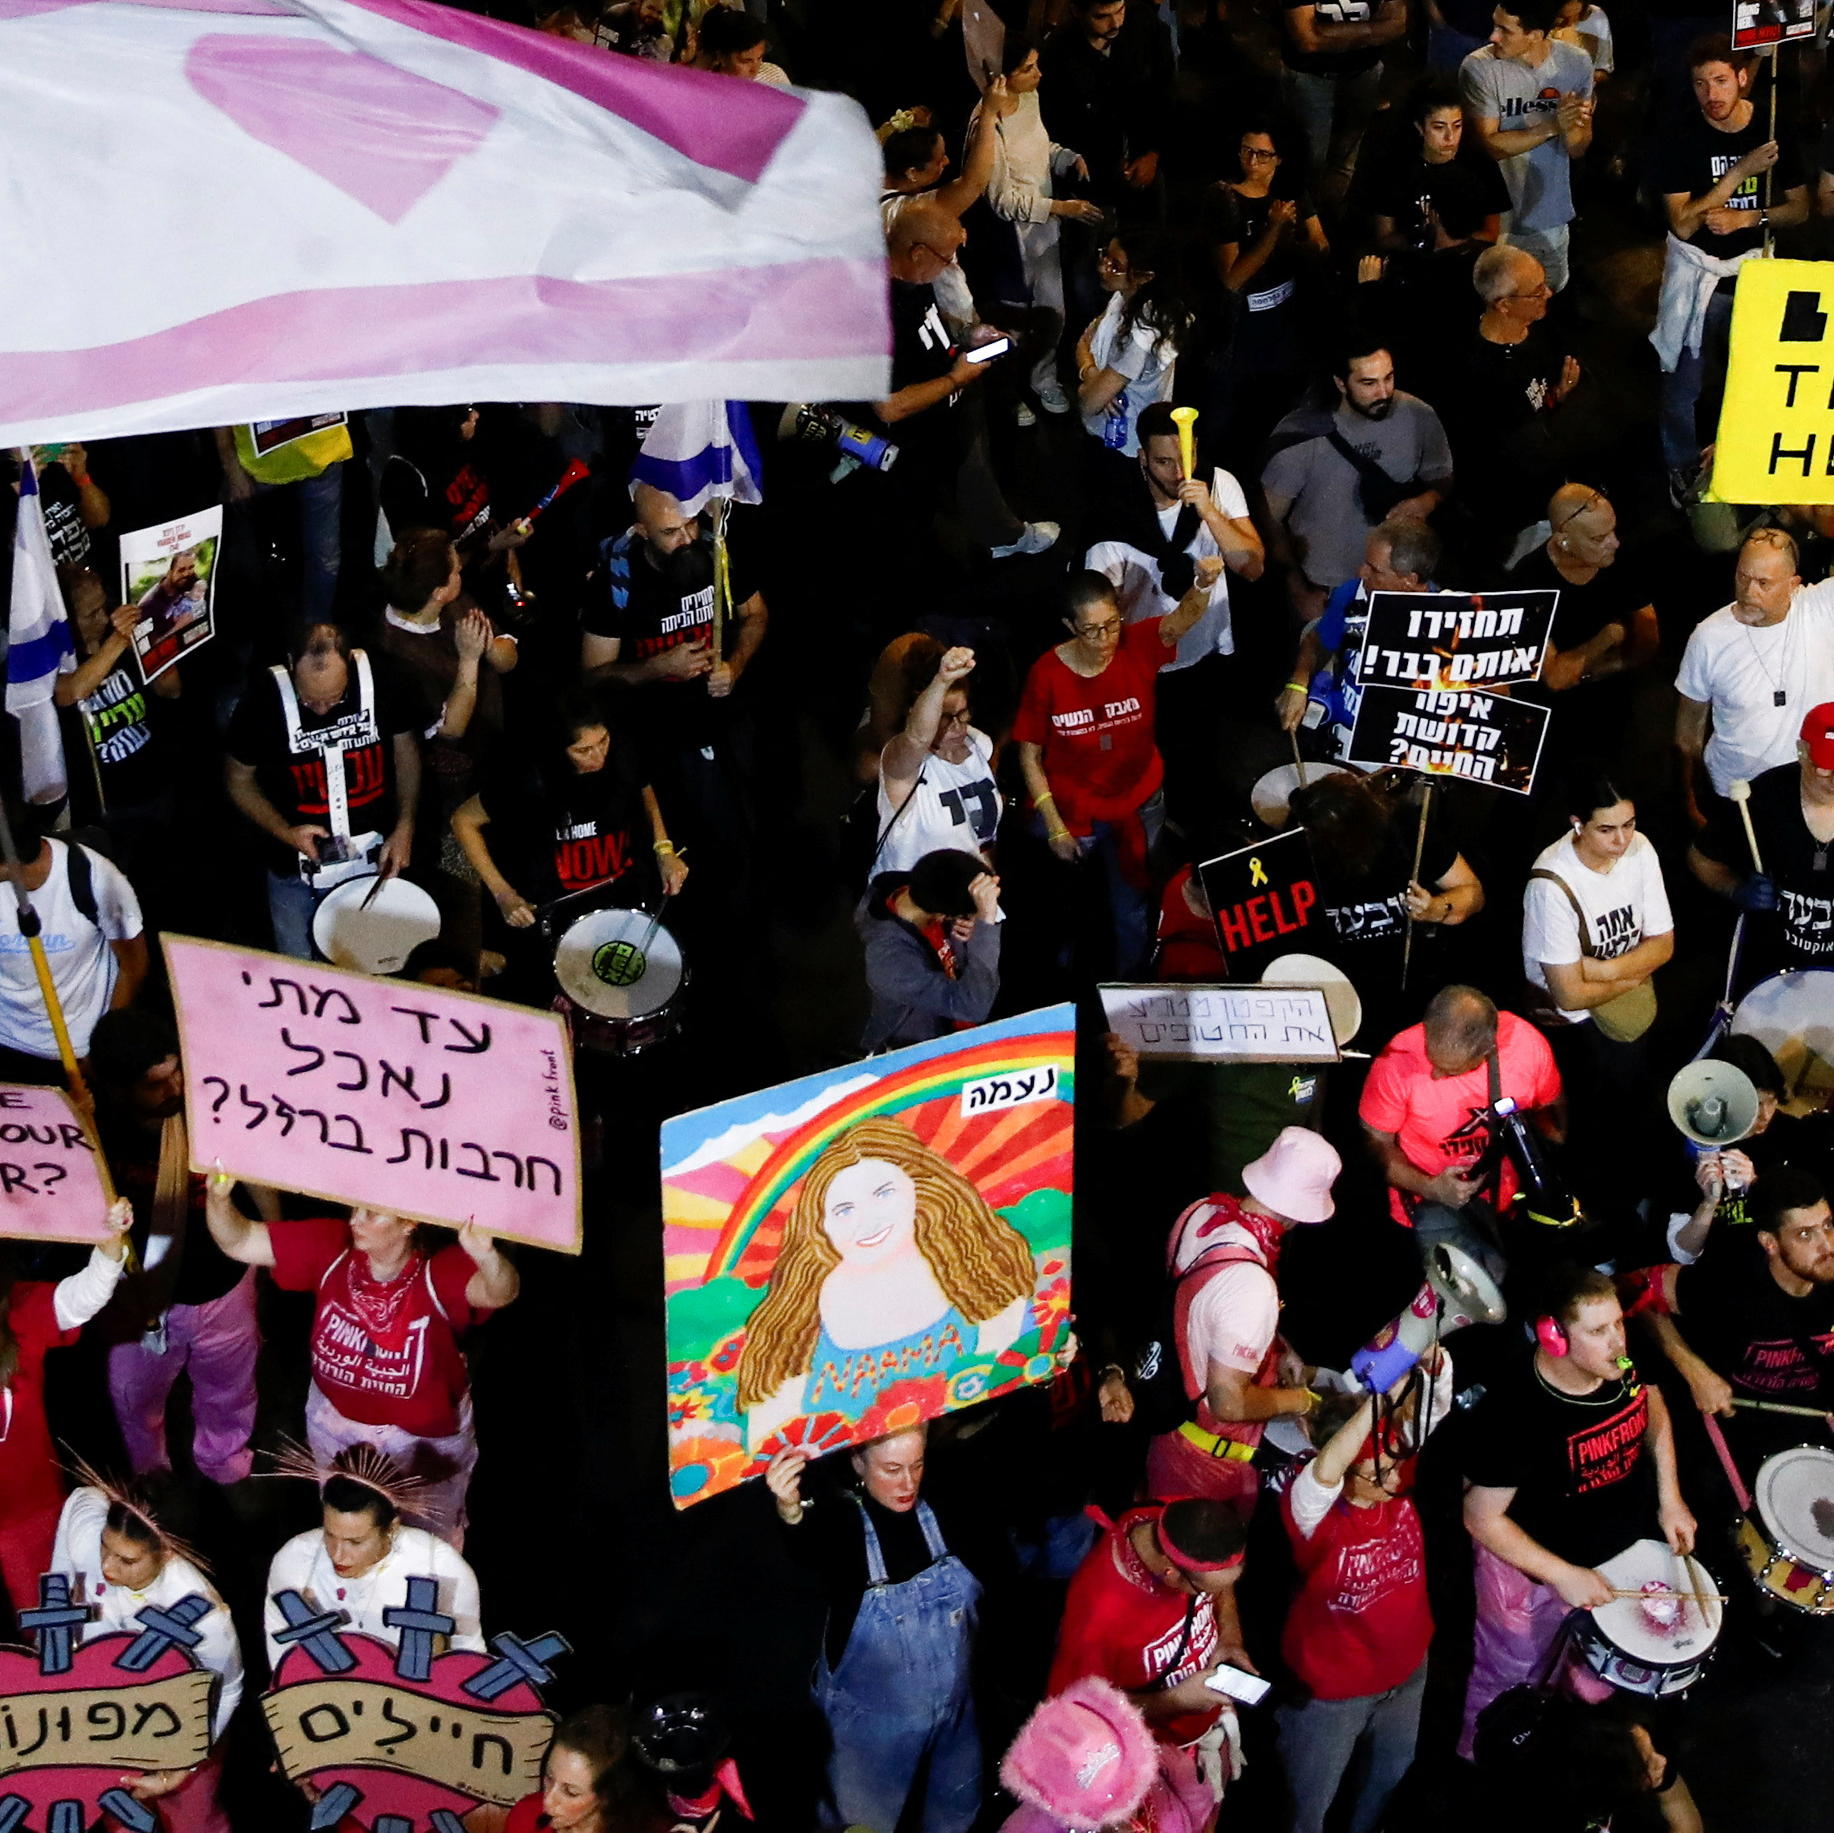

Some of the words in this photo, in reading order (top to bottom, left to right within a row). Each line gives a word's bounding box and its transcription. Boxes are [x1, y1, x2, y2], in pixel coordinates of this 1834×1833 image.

[1406, 608, 1525, 640] תחזירו
[1364, 645, 1443, 681] כבר!
[1448, 645, 1539, 683] אותם
[1051, 708, 1095, 729] הנשים
[1105, 695, 1141, 718] מאבק
[1413, 690, 1494, 721] איפה
[1393, 711, 1502, 752] קדושת
[1388, 738, 1497, 782] החיים?
[571, 821, 598, 839] HOME
[1217, 878, 1318, 952] HELP
[1595, 904, 1635, 940] אתה
[241, 970, 362, 1025] מתי
[391, 1004, 490, 1054] עד
[1141, 1021, 1268, 1044] החטופים
[1281, 1023, 1324, 1043] את
[282, 1026, 451, 1109] נאכל
[969, 1067, 1058, 1109] נעמה
[203, 1075, 373, 1155] ברזל?
[388, 1126, 562, 1196] חרבות
[820, 1323, 964, 1404] NAAMA
[300, 1697, 516, 1774] חיילים
